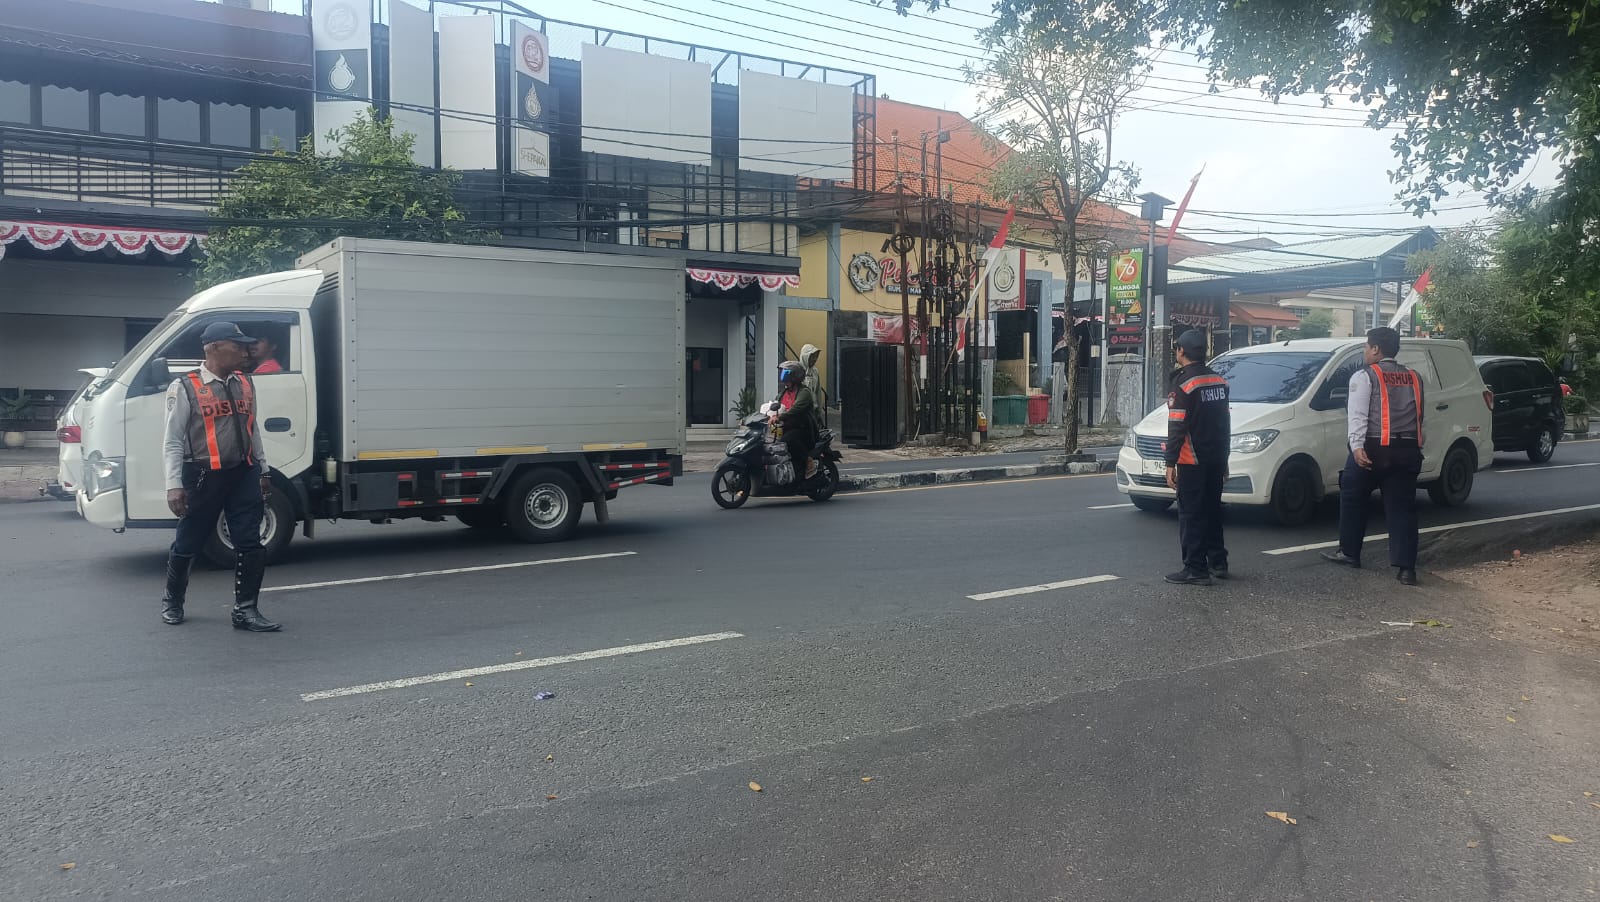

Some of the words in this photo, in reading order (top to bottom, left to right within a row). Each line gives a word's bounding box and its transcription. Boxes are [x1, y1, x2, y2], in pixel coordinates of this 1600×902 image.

[1118, 258, 1136, 280] 76
[1383, 371, 1414, 385] DISHUB
[1200, 387, 1226, 402] DISHUB
